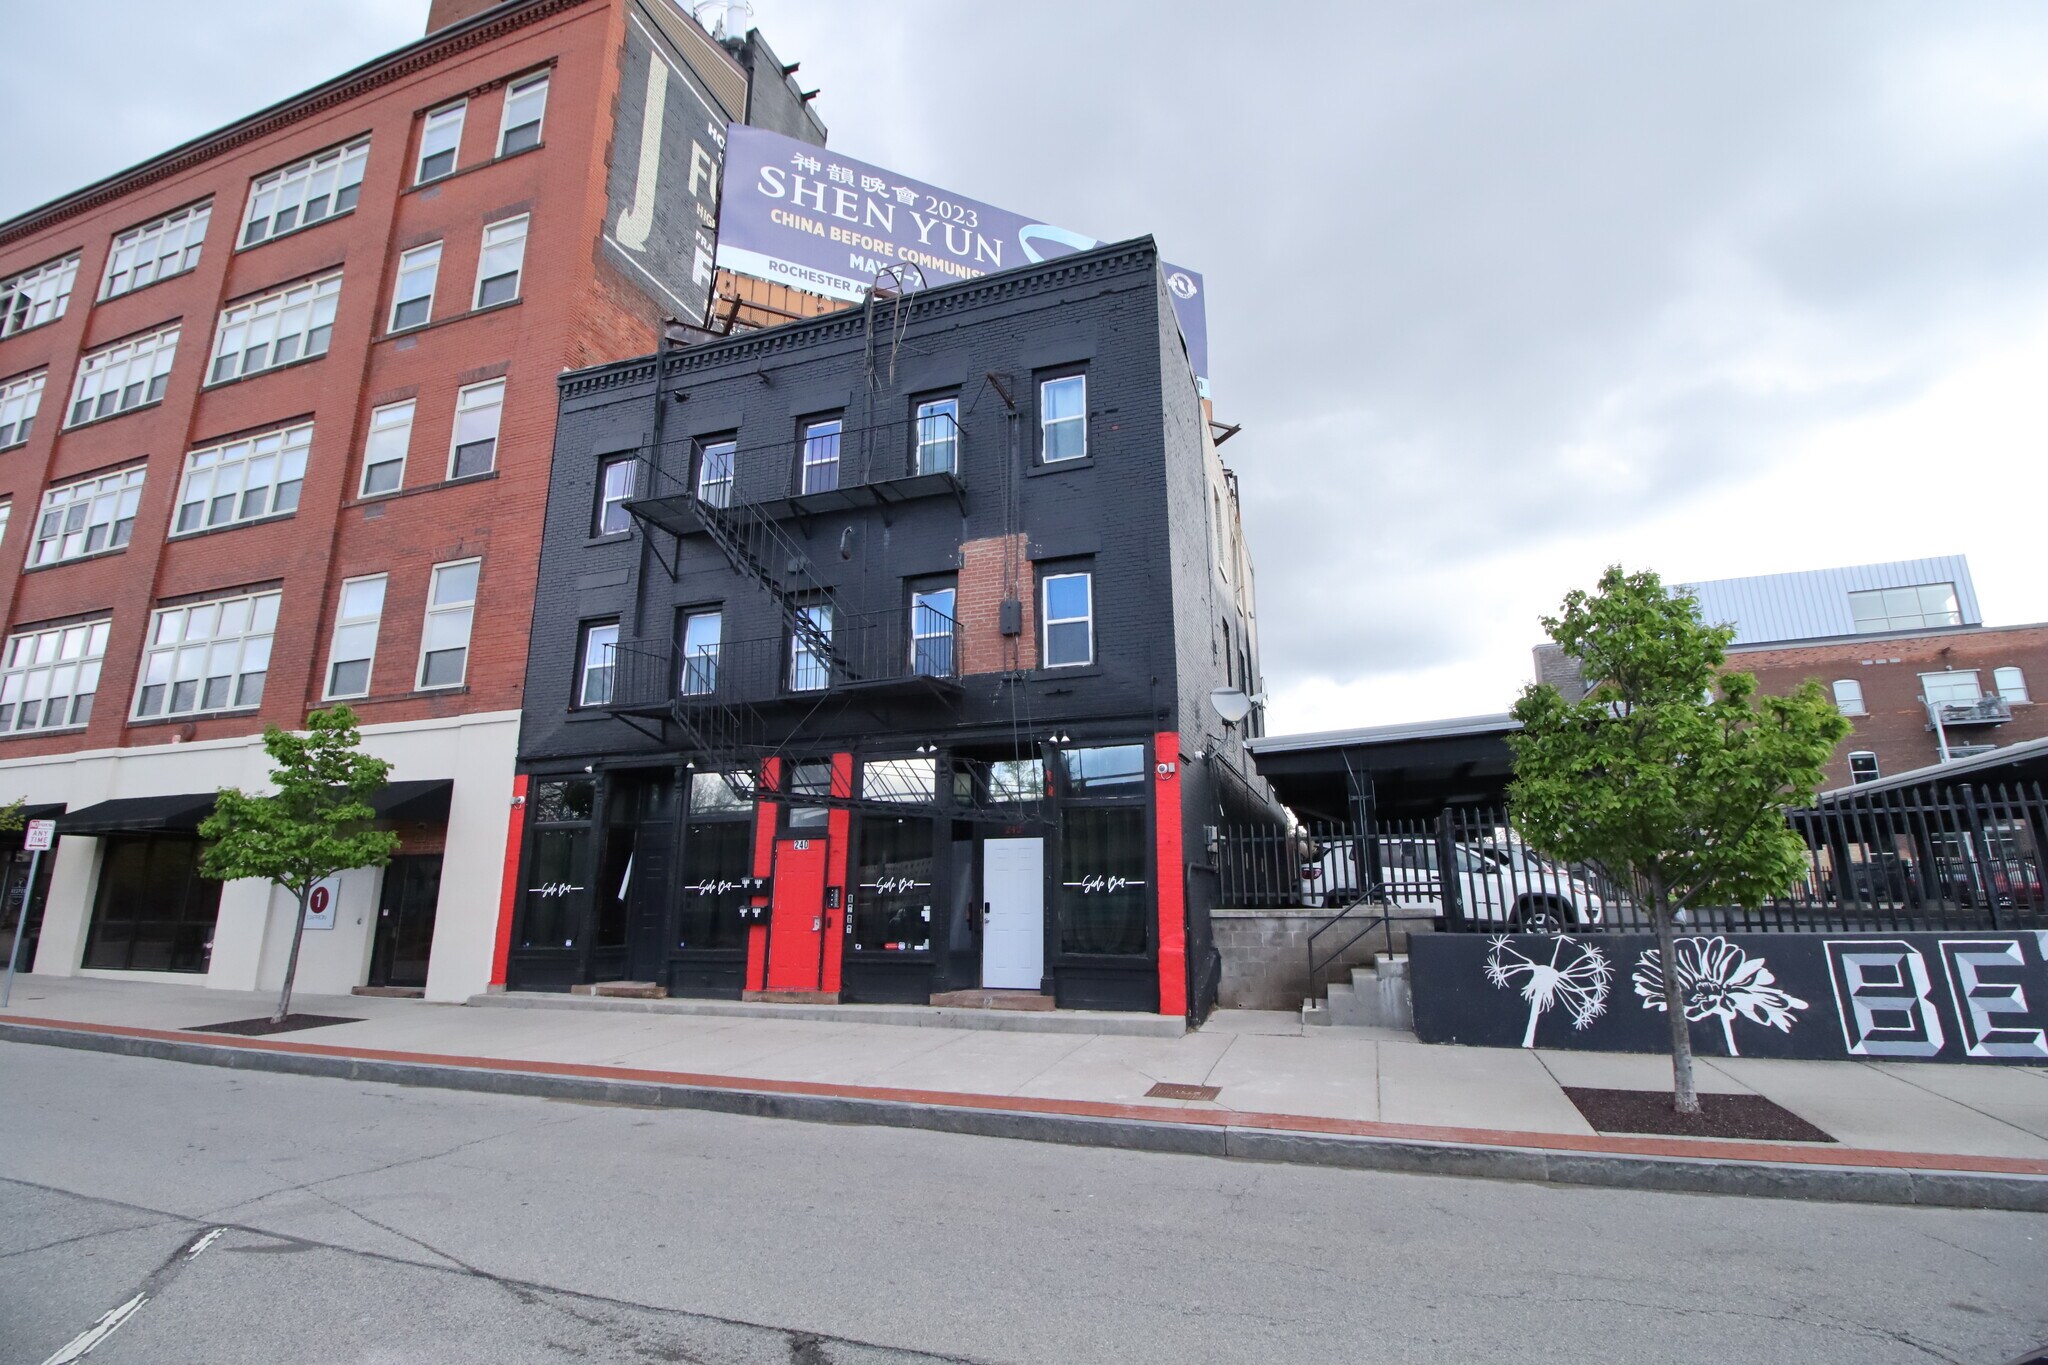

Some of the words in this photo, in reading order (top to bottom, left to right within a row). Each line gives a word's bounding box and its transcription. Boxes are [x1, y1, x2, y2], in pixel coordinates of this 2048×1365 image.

[616, 50, 668, 251] J
[790, 152, 919, 206] 神韻晚會
[925, 195, 978, 228] 2023
[757, 165, 896, 234] SHEN
[909, 210, 1004, 268] YUN
[770, 209, 825, 237] CHINA
[830, 226, 894, 256] BEFORE
[897, 246, 986, 280] COMMUNIS
[849, 253, 888, 277] MAY
[768, 260, 851, 292] ROCHESTER
[795, 840, 808, 849] 240
[316, 891, 323, 908] 1
